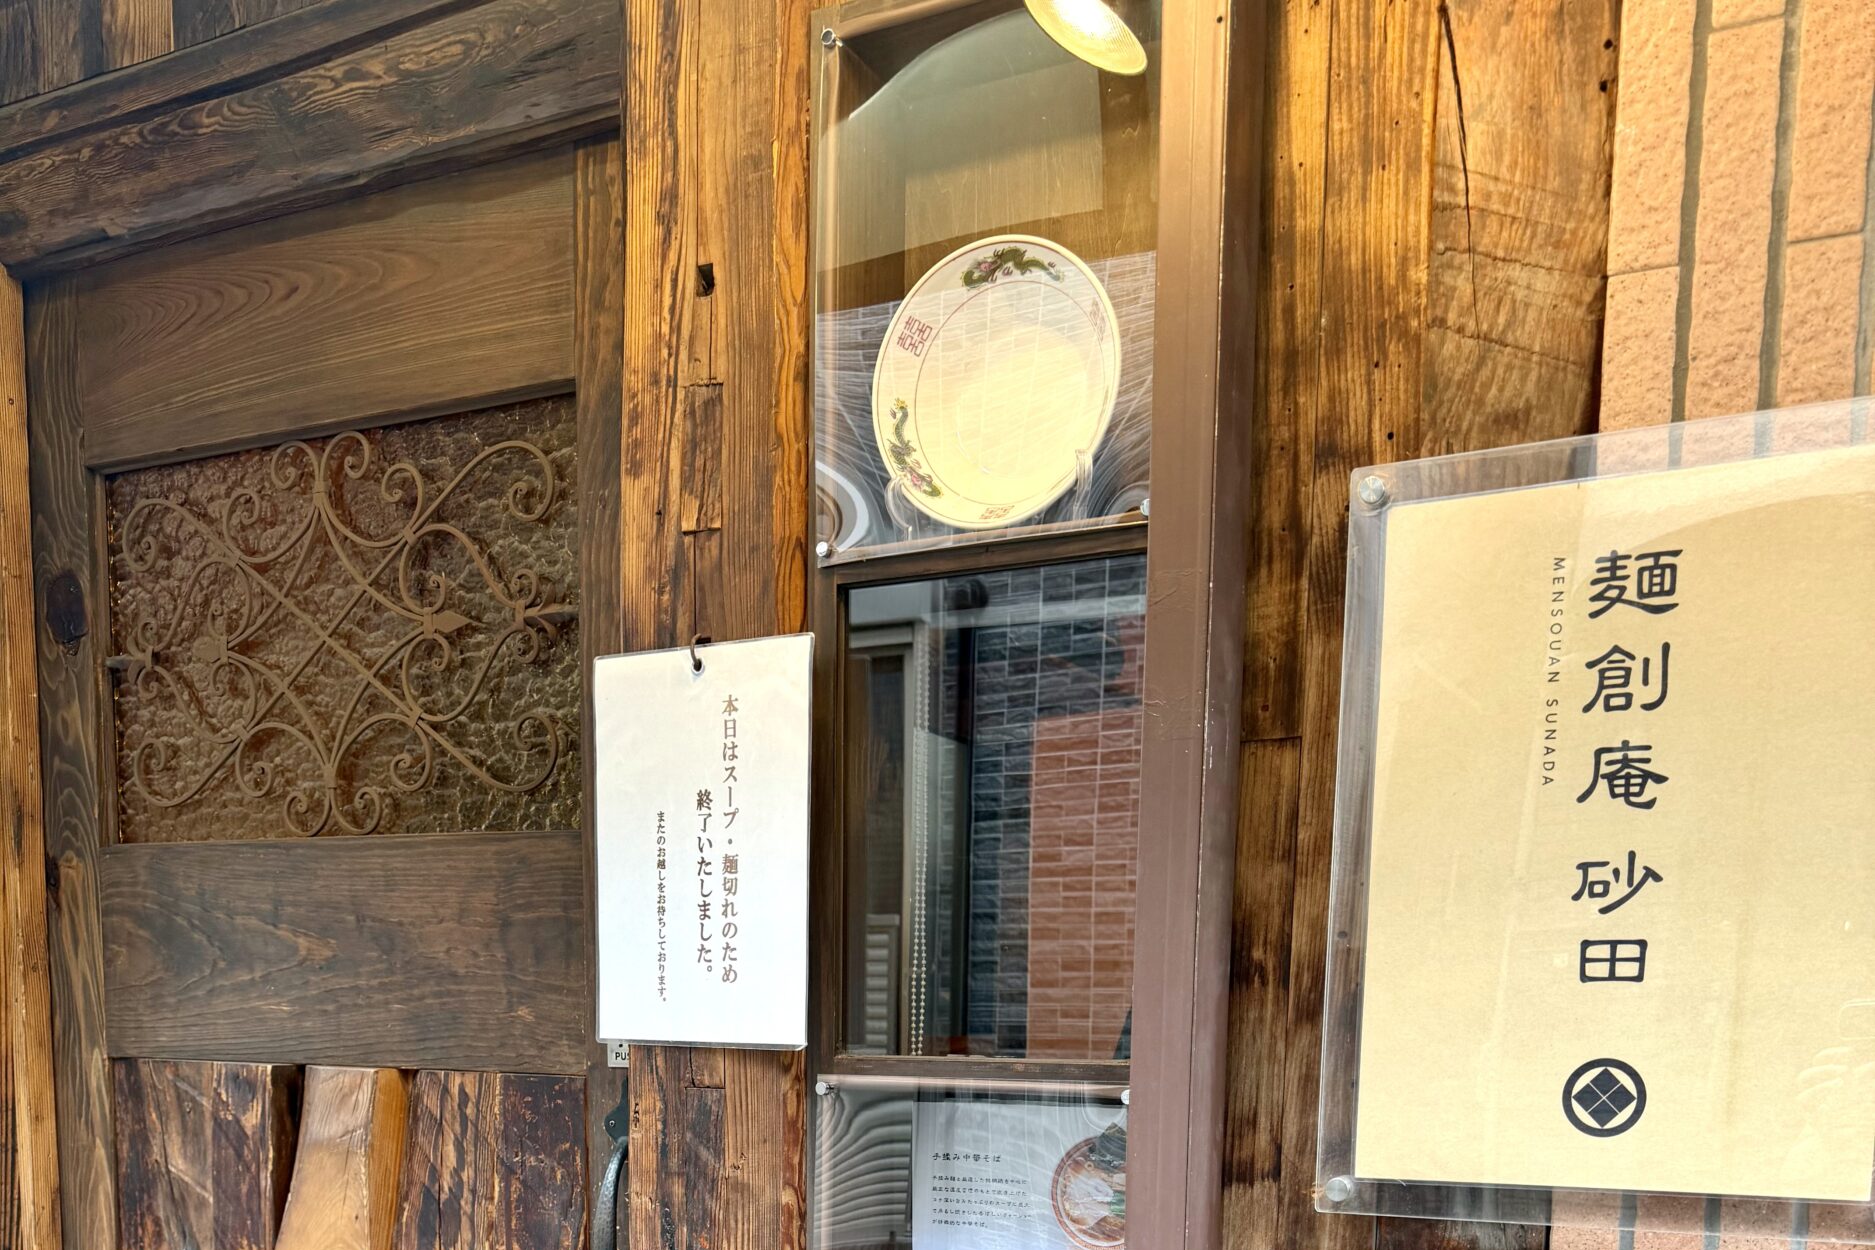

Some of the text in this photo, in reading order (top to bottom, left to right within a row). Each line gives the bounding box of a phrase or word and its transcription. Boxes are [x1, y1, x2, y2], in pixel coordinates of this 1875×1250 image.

[1542, 556, 1566, 787] MENSOUAN SUNADA
[1572, 548, 1683, 984] 麺創庵砂田
[656, 810, 666, 1002] またのお越しをお待ちしております。
[696, 789, 713, 973] 終了いたしました。
[721, 694, 740, 984] 本日はスープ・麺切れのため
